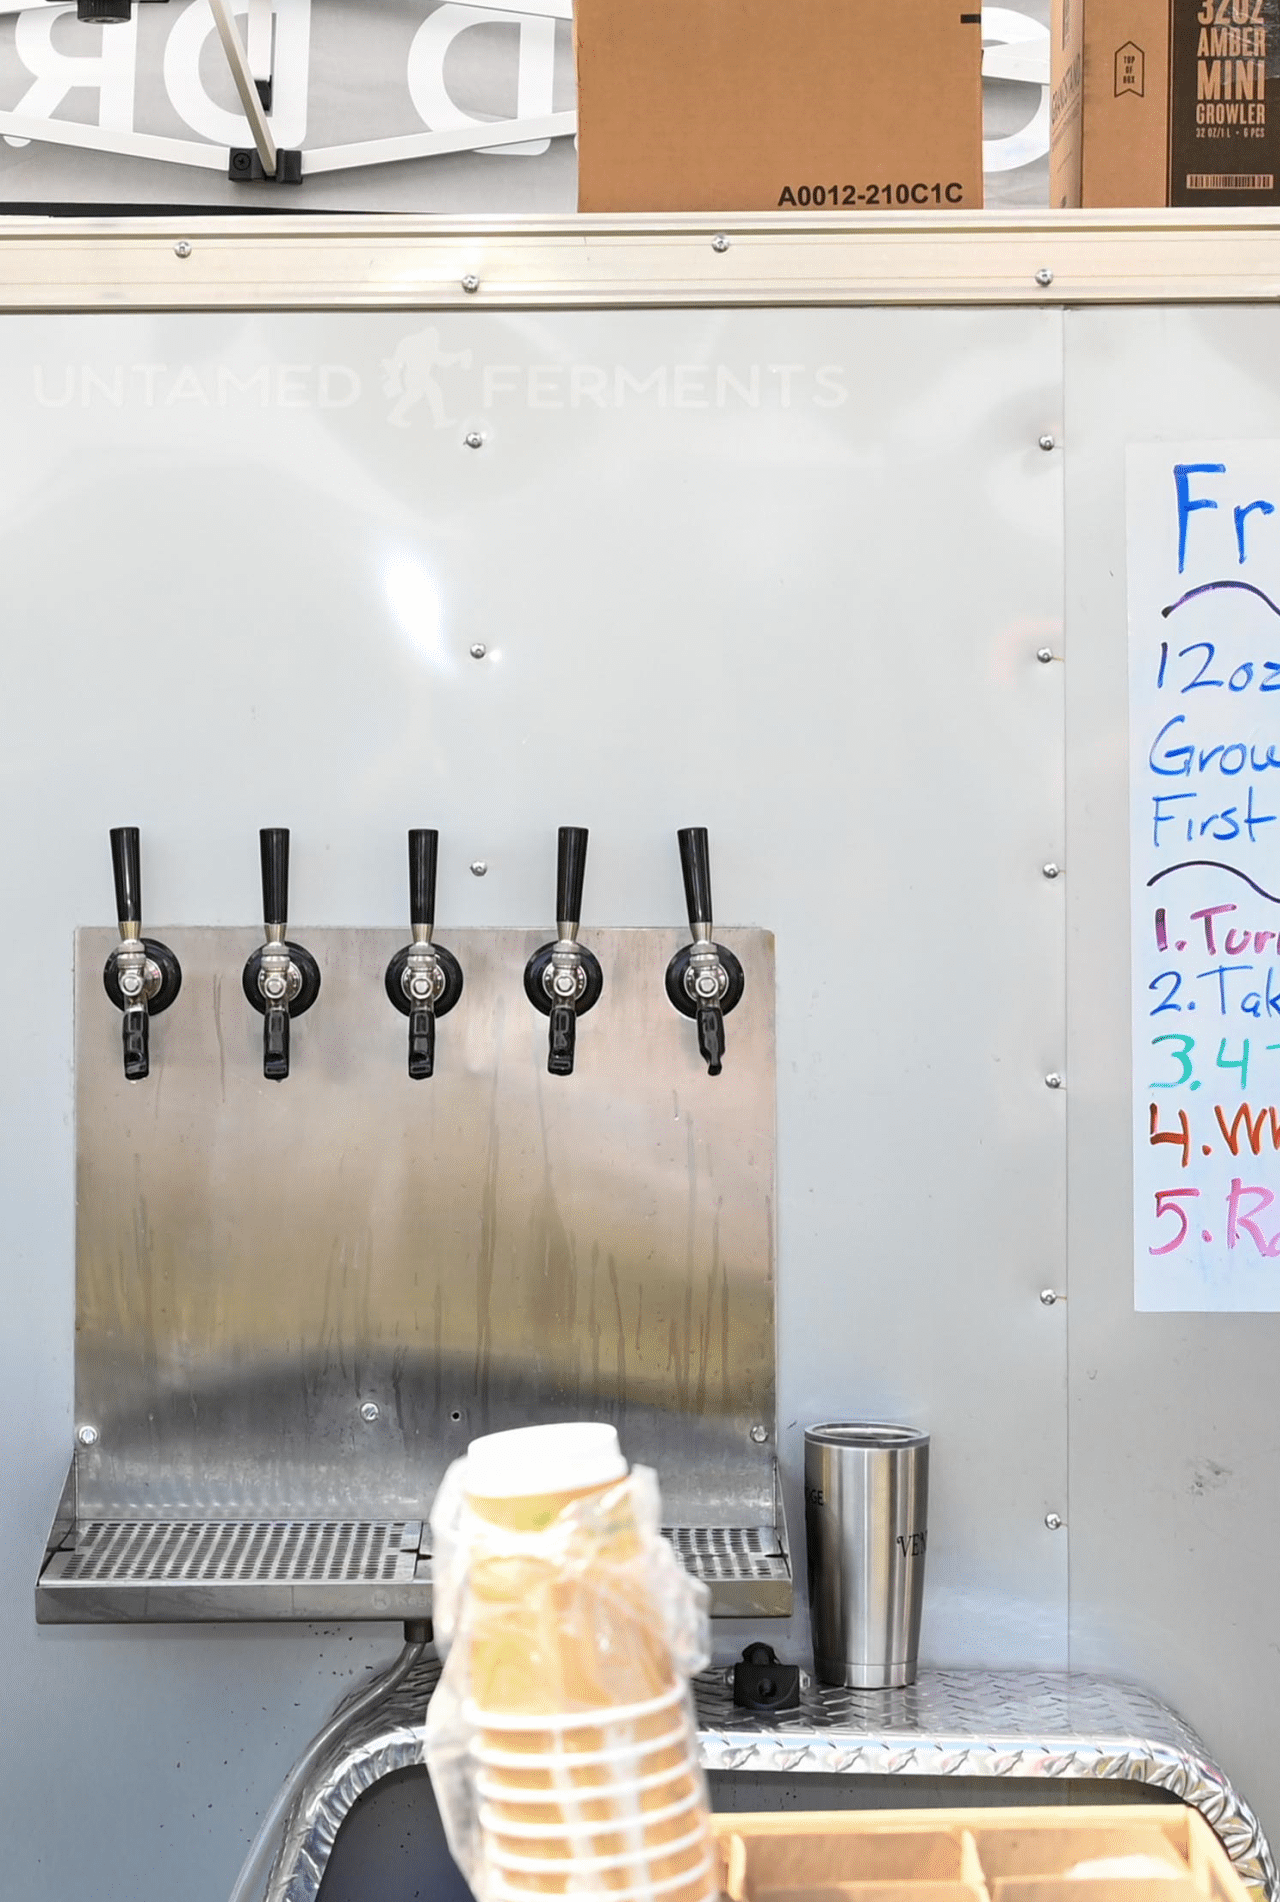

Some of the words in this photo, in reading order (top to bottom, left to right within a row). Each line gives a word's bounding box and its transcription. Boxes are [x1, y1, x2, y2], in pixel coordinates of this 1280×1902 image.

[1196, 26, 1267, 58] AMBER
[1123, 55, 1136, 65] TOP
[1125, 65, 1133, 75] OF
[1122, 75, 1135, 84] BOX
[1196, 59, 1266, 101] MINI
[1195, 103, 1266, 125] GROWLER
[1195, 127, 1206, 138] 32
[1250, 127, 1266, 138] PCS
[777, 182, 964, 207] A0012-210C1C
[33, 363, 362, 409] UNTAMED
[482, 363, 851, 409] FERMENTS
[1151, 786, 1278, 848] First
